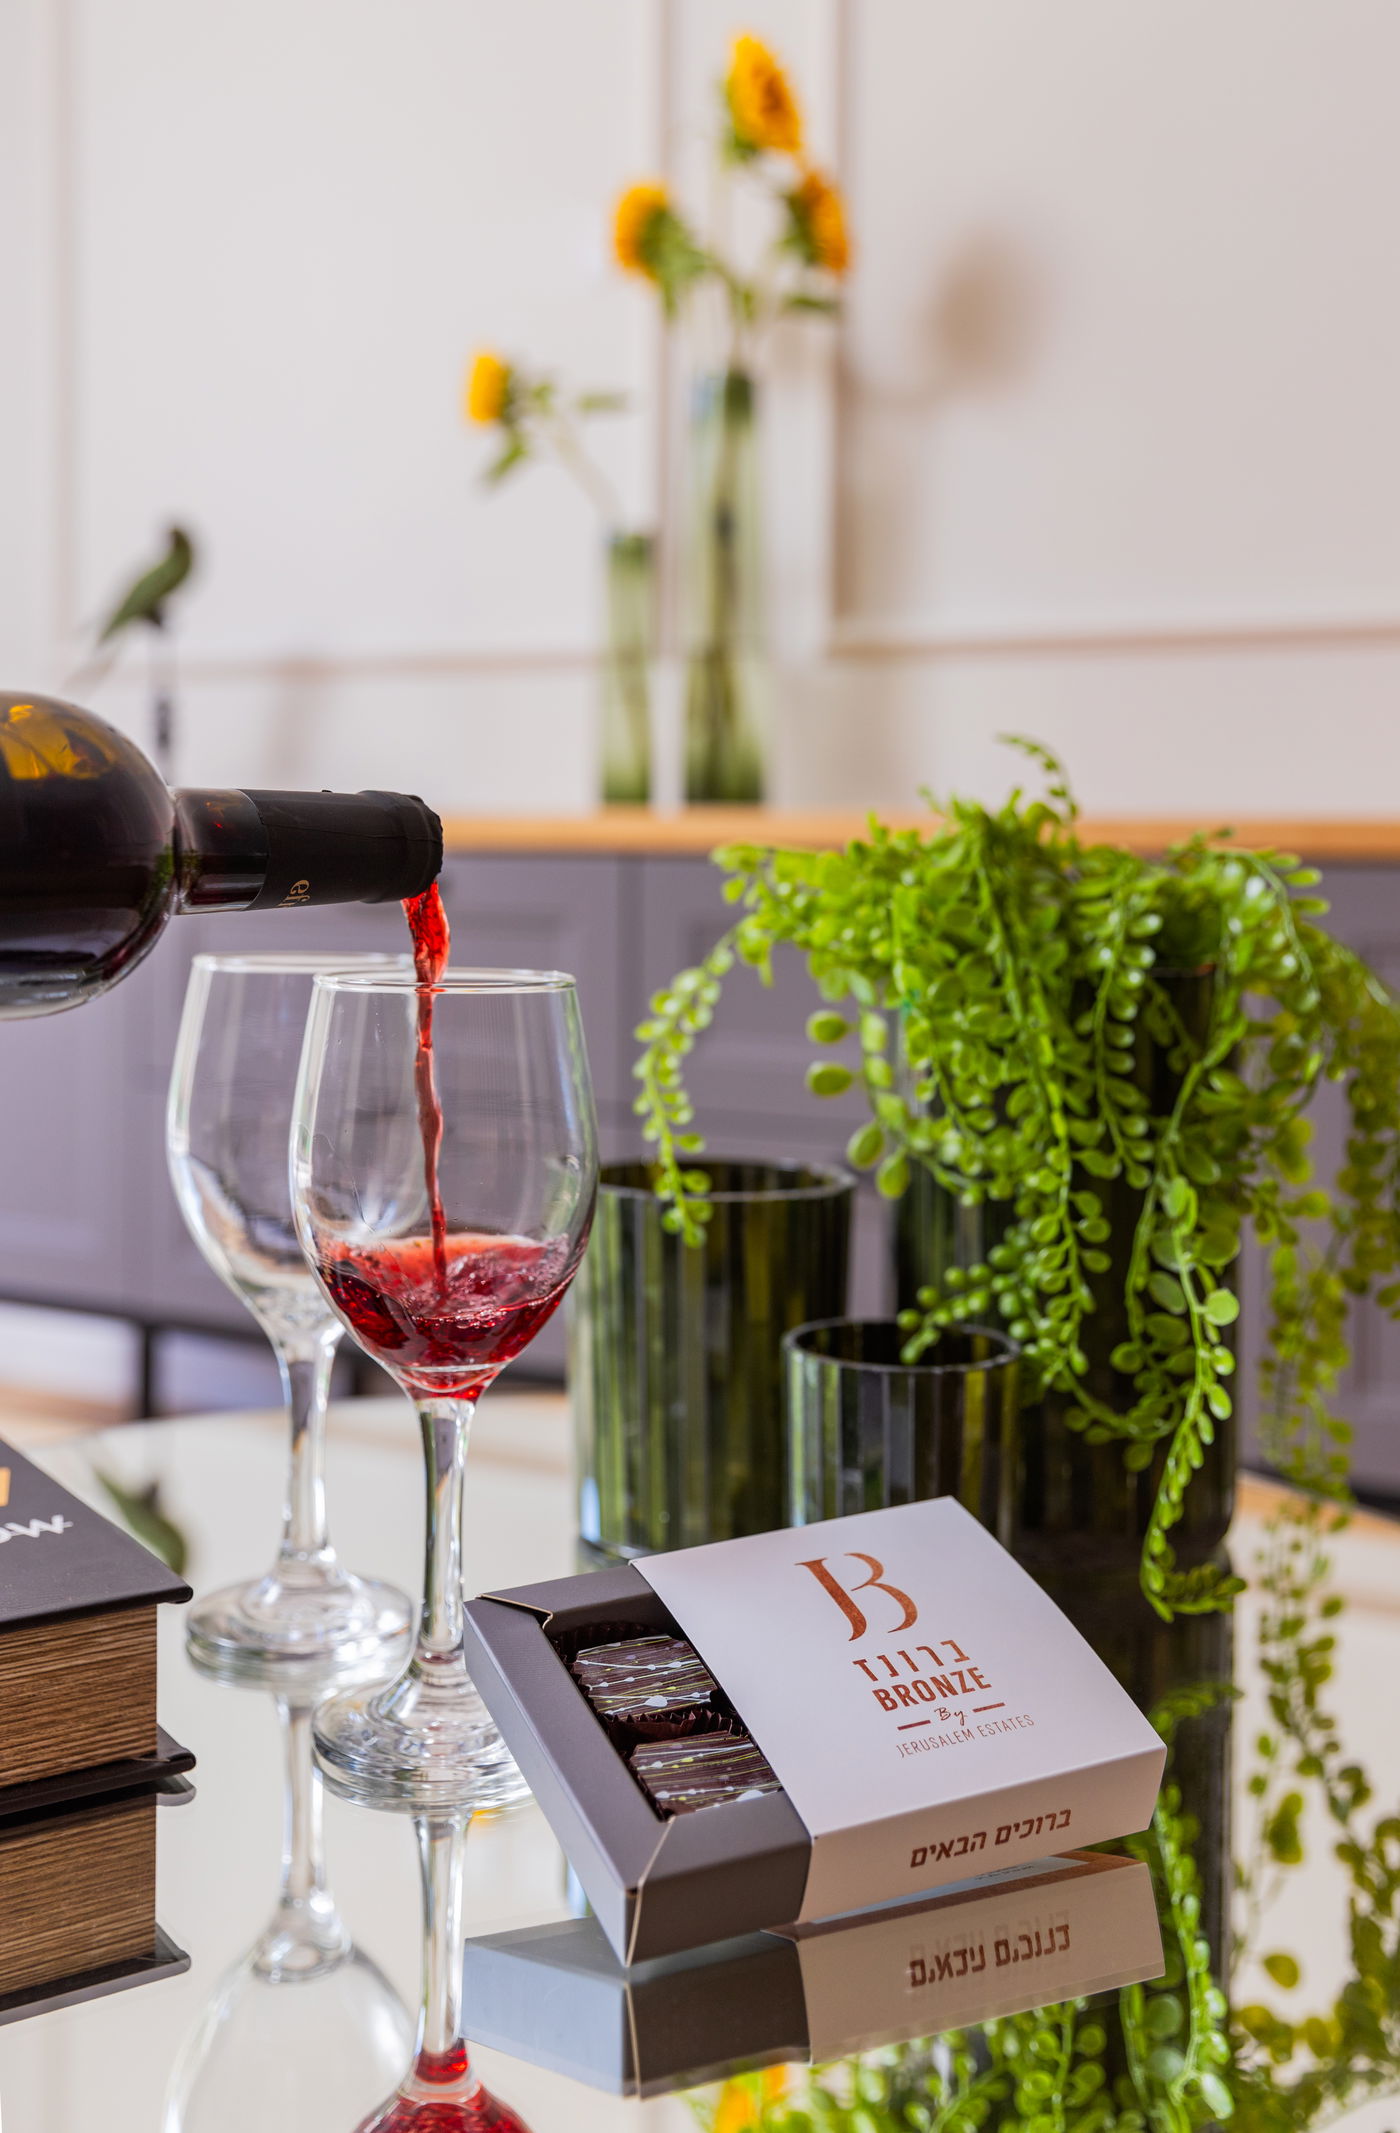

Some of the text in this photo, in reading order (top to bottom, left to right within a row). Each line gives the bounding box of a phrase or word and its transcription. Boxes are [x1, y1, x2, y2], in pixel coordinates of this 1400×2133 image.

[852, 1639, 971, 1683] ברונז
[872, 1666, 992, 1712] BRONZE
[896, 1713, 1035, 1758] JERUSALEM ESTATES
[934, 1706, 968, 1726] By
[910, 1808, 1072, 1868] ברוכים הבאים
